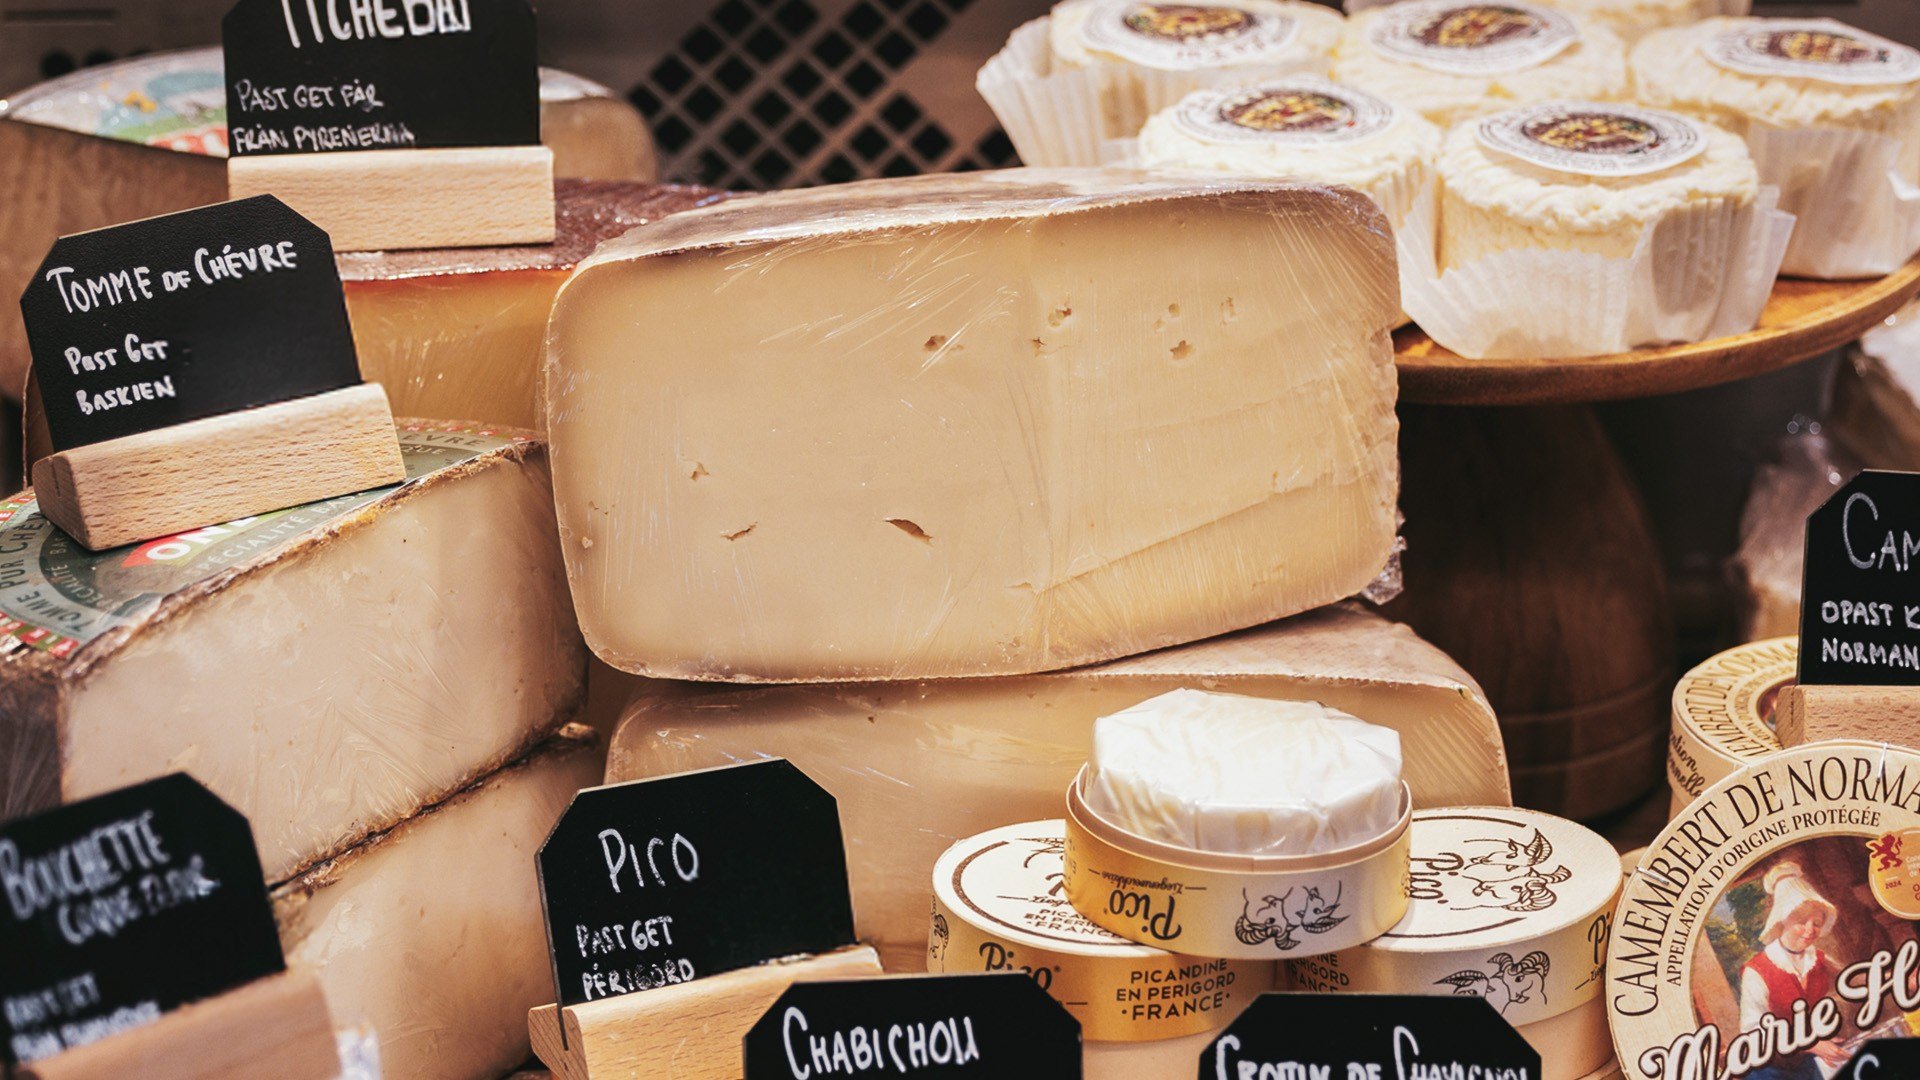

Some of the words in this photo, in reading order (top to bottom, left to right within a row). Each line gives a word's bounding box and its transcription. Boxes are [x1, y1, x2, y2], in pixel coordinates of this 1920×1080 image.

[293, 84, 334, 109] GET
[46, 266, 153, 313] TOMME
[76, 375, 176, 415] BASKIEN
[1821, 600, 1894, 627] OPAST
[1904, 605, 1920, 629] K
[1822, 638, 1920, 671] NORMAN
[598, 828, 699, 893] PICO
[1613, 801, 1732, 1016] CAMEMBERT
[1723, 770, 1784, 829] DE
[1787, 756, 1920, 814] NORMA
[1666, 878, 1715, 986] APPELLATION
[1710, 819, 1790, 882] D'ORIGINE
[1792, 804, 1881, 831] PROTÉGÉE
[576, 924, 626, 958] PAST
[631, 915, 673, 951] GET
[1109, 889, 1183, 941] Pico
[1587, 911, 1611, 965] Pi
[1116, 988, 1141, 1001] EN
[1148, 971, 1236, 1001] PERIGORD
[1130, 958, 1228, 984] PICANDINE
[1132, 991, 1223, 1021] FRANCE
[1639, 997, 1842, 1080] Marie
